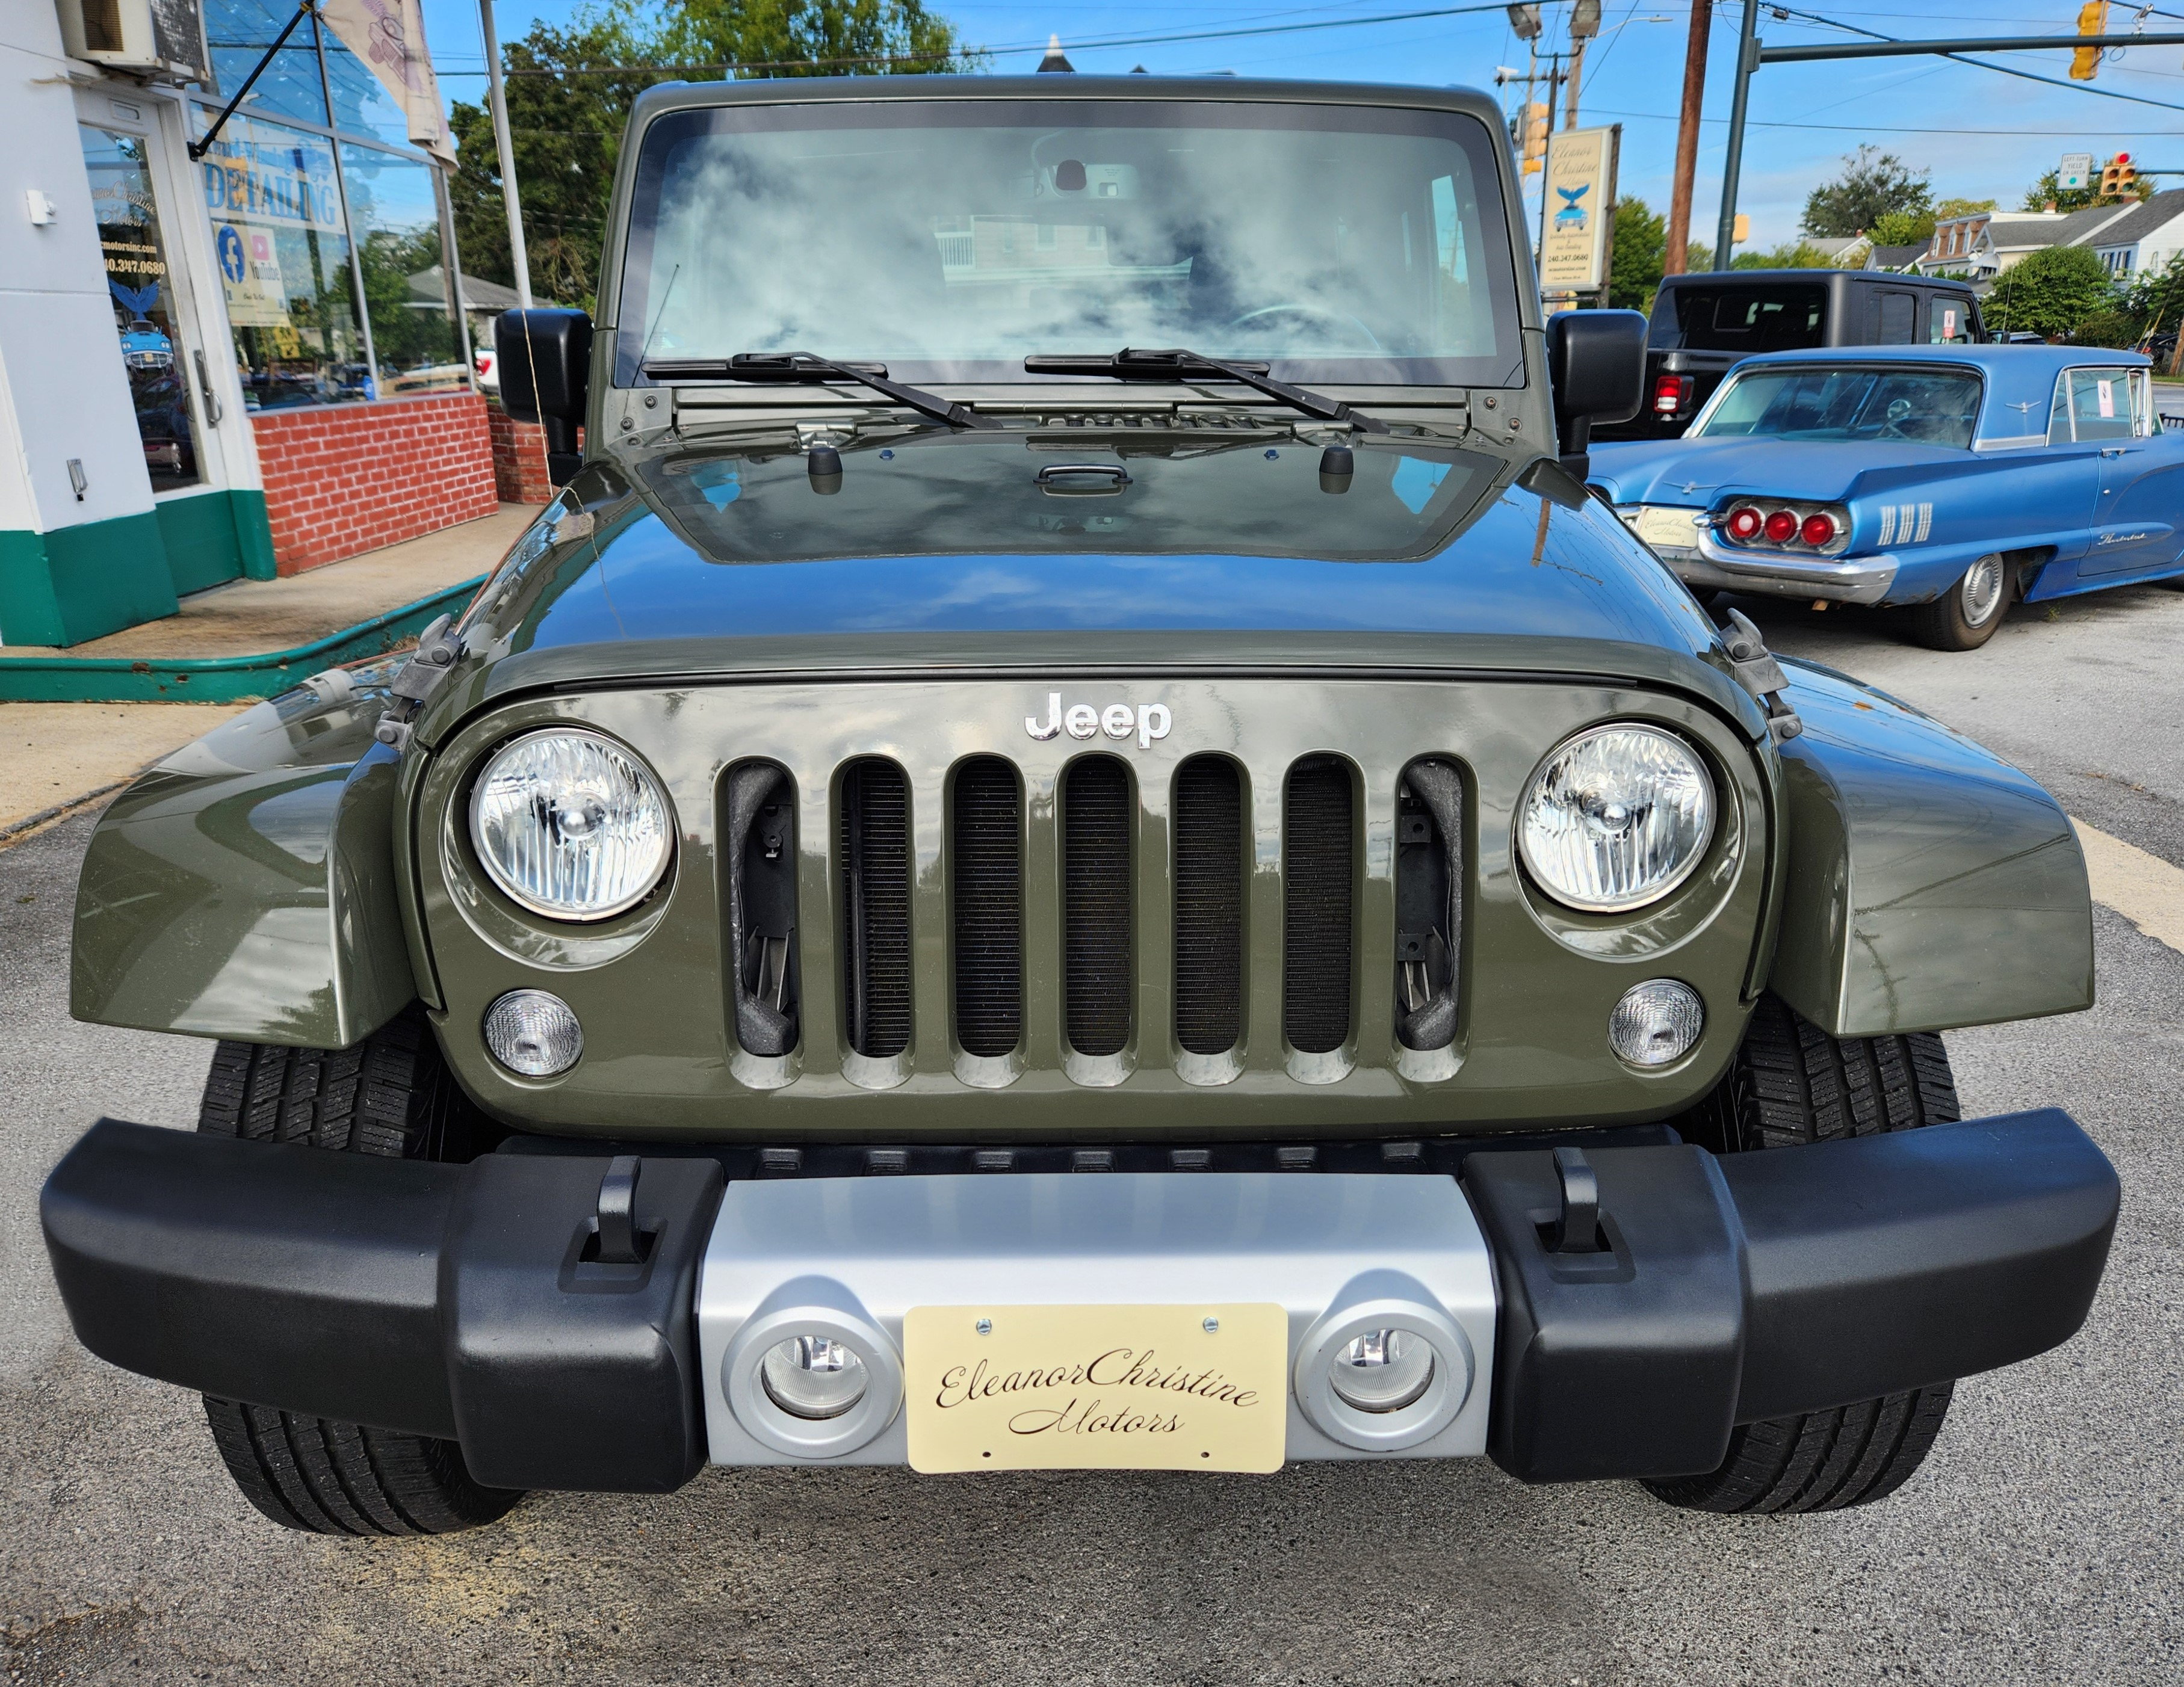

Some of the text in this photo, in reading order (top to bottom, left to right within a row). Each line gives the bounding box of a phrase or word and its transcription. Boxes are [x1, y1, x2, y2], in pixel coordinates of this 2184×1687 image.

[1551, 143, 1591, 159] Eleanor
[1553, 160, 1598, 176] Christine
[203, 162, 336, 225] DETAILING
[250, 261, 280, 281] YouTube
[1024, 691, 1172, 750] Jeep
[1008, 1398, 1186, 1435] Motors
